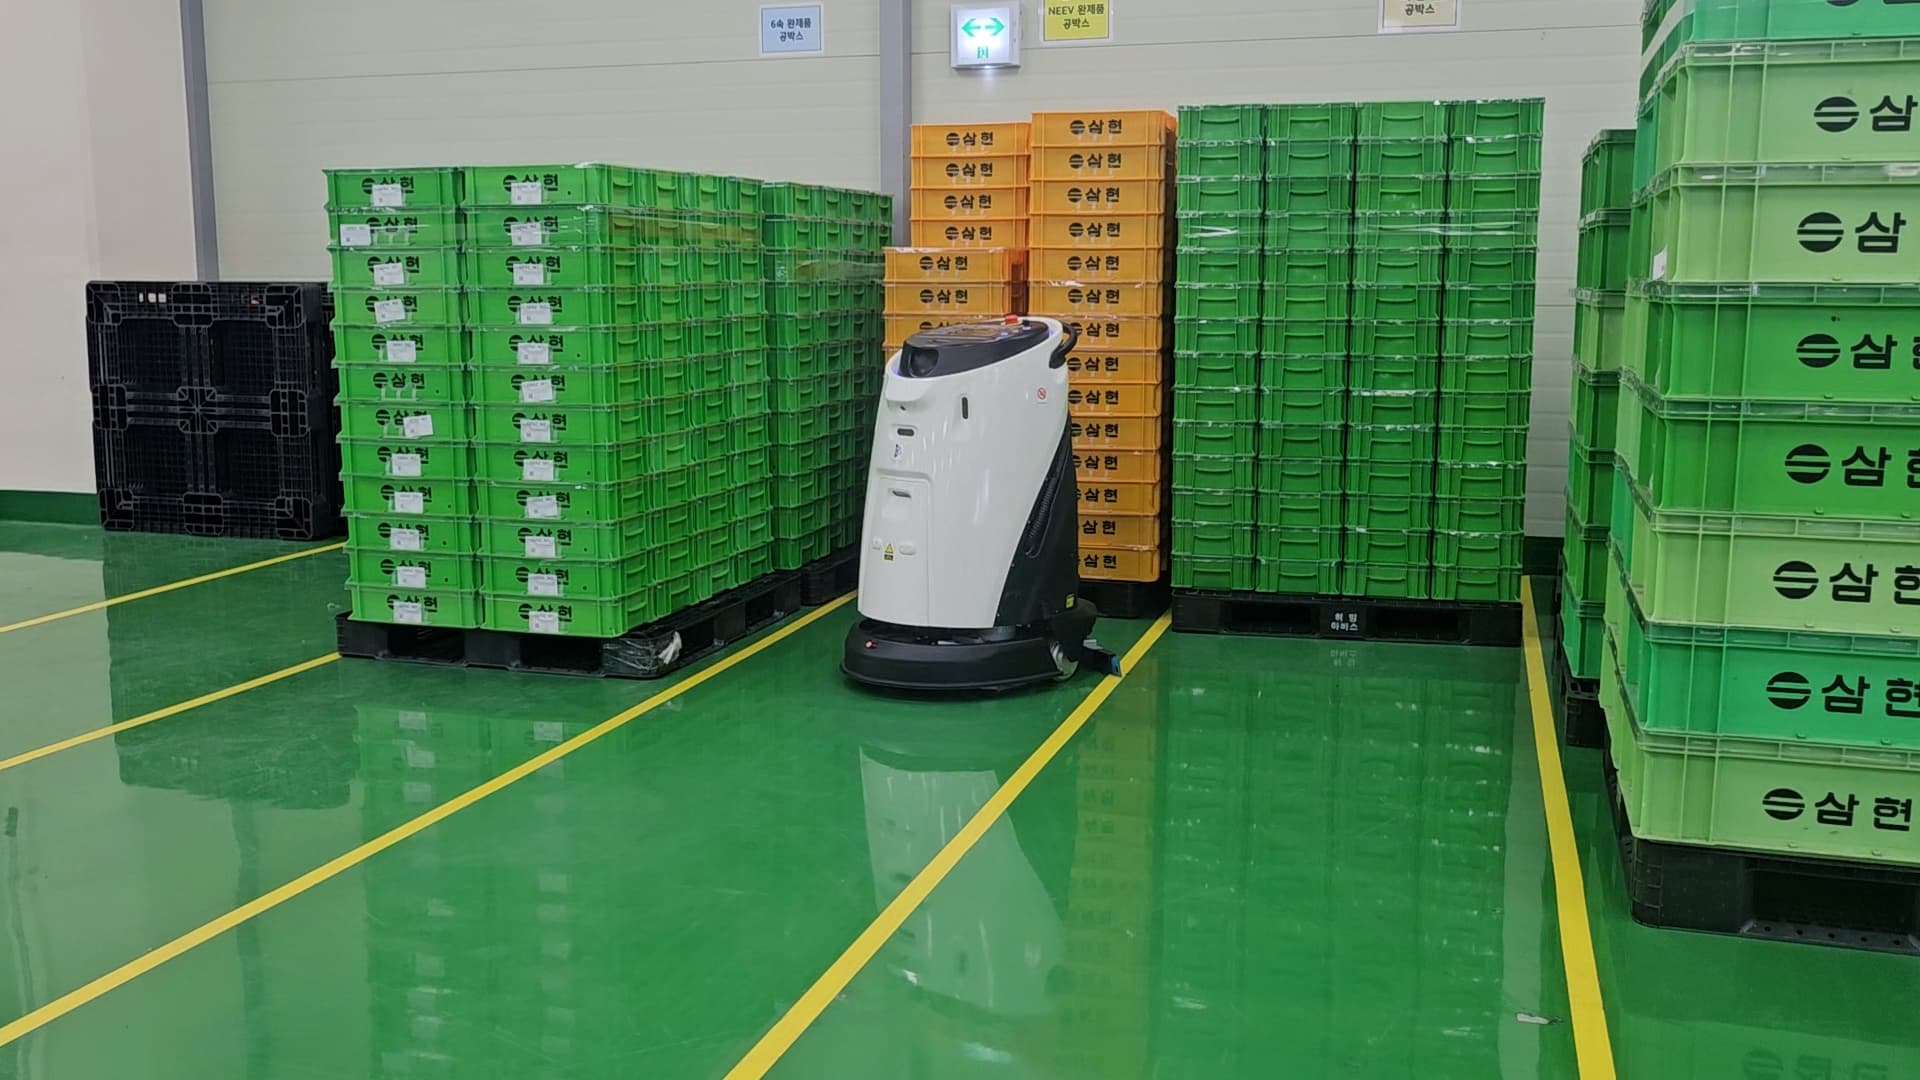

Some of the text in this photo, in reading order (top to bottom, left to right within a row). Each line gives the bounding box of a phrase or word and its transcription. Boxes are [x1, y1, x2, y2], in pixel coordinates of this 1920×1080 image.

[1048, 3, 1105, 16] NEEV 완제품
[1405, 3, 1436, 17] 공박스
[787, 17, 811, 29] 완제품
[1063, 18, 1091, 30] 공박스
[780, 31, 804, 42] 공박스
[1851, 334, 1920, 369] 삼
